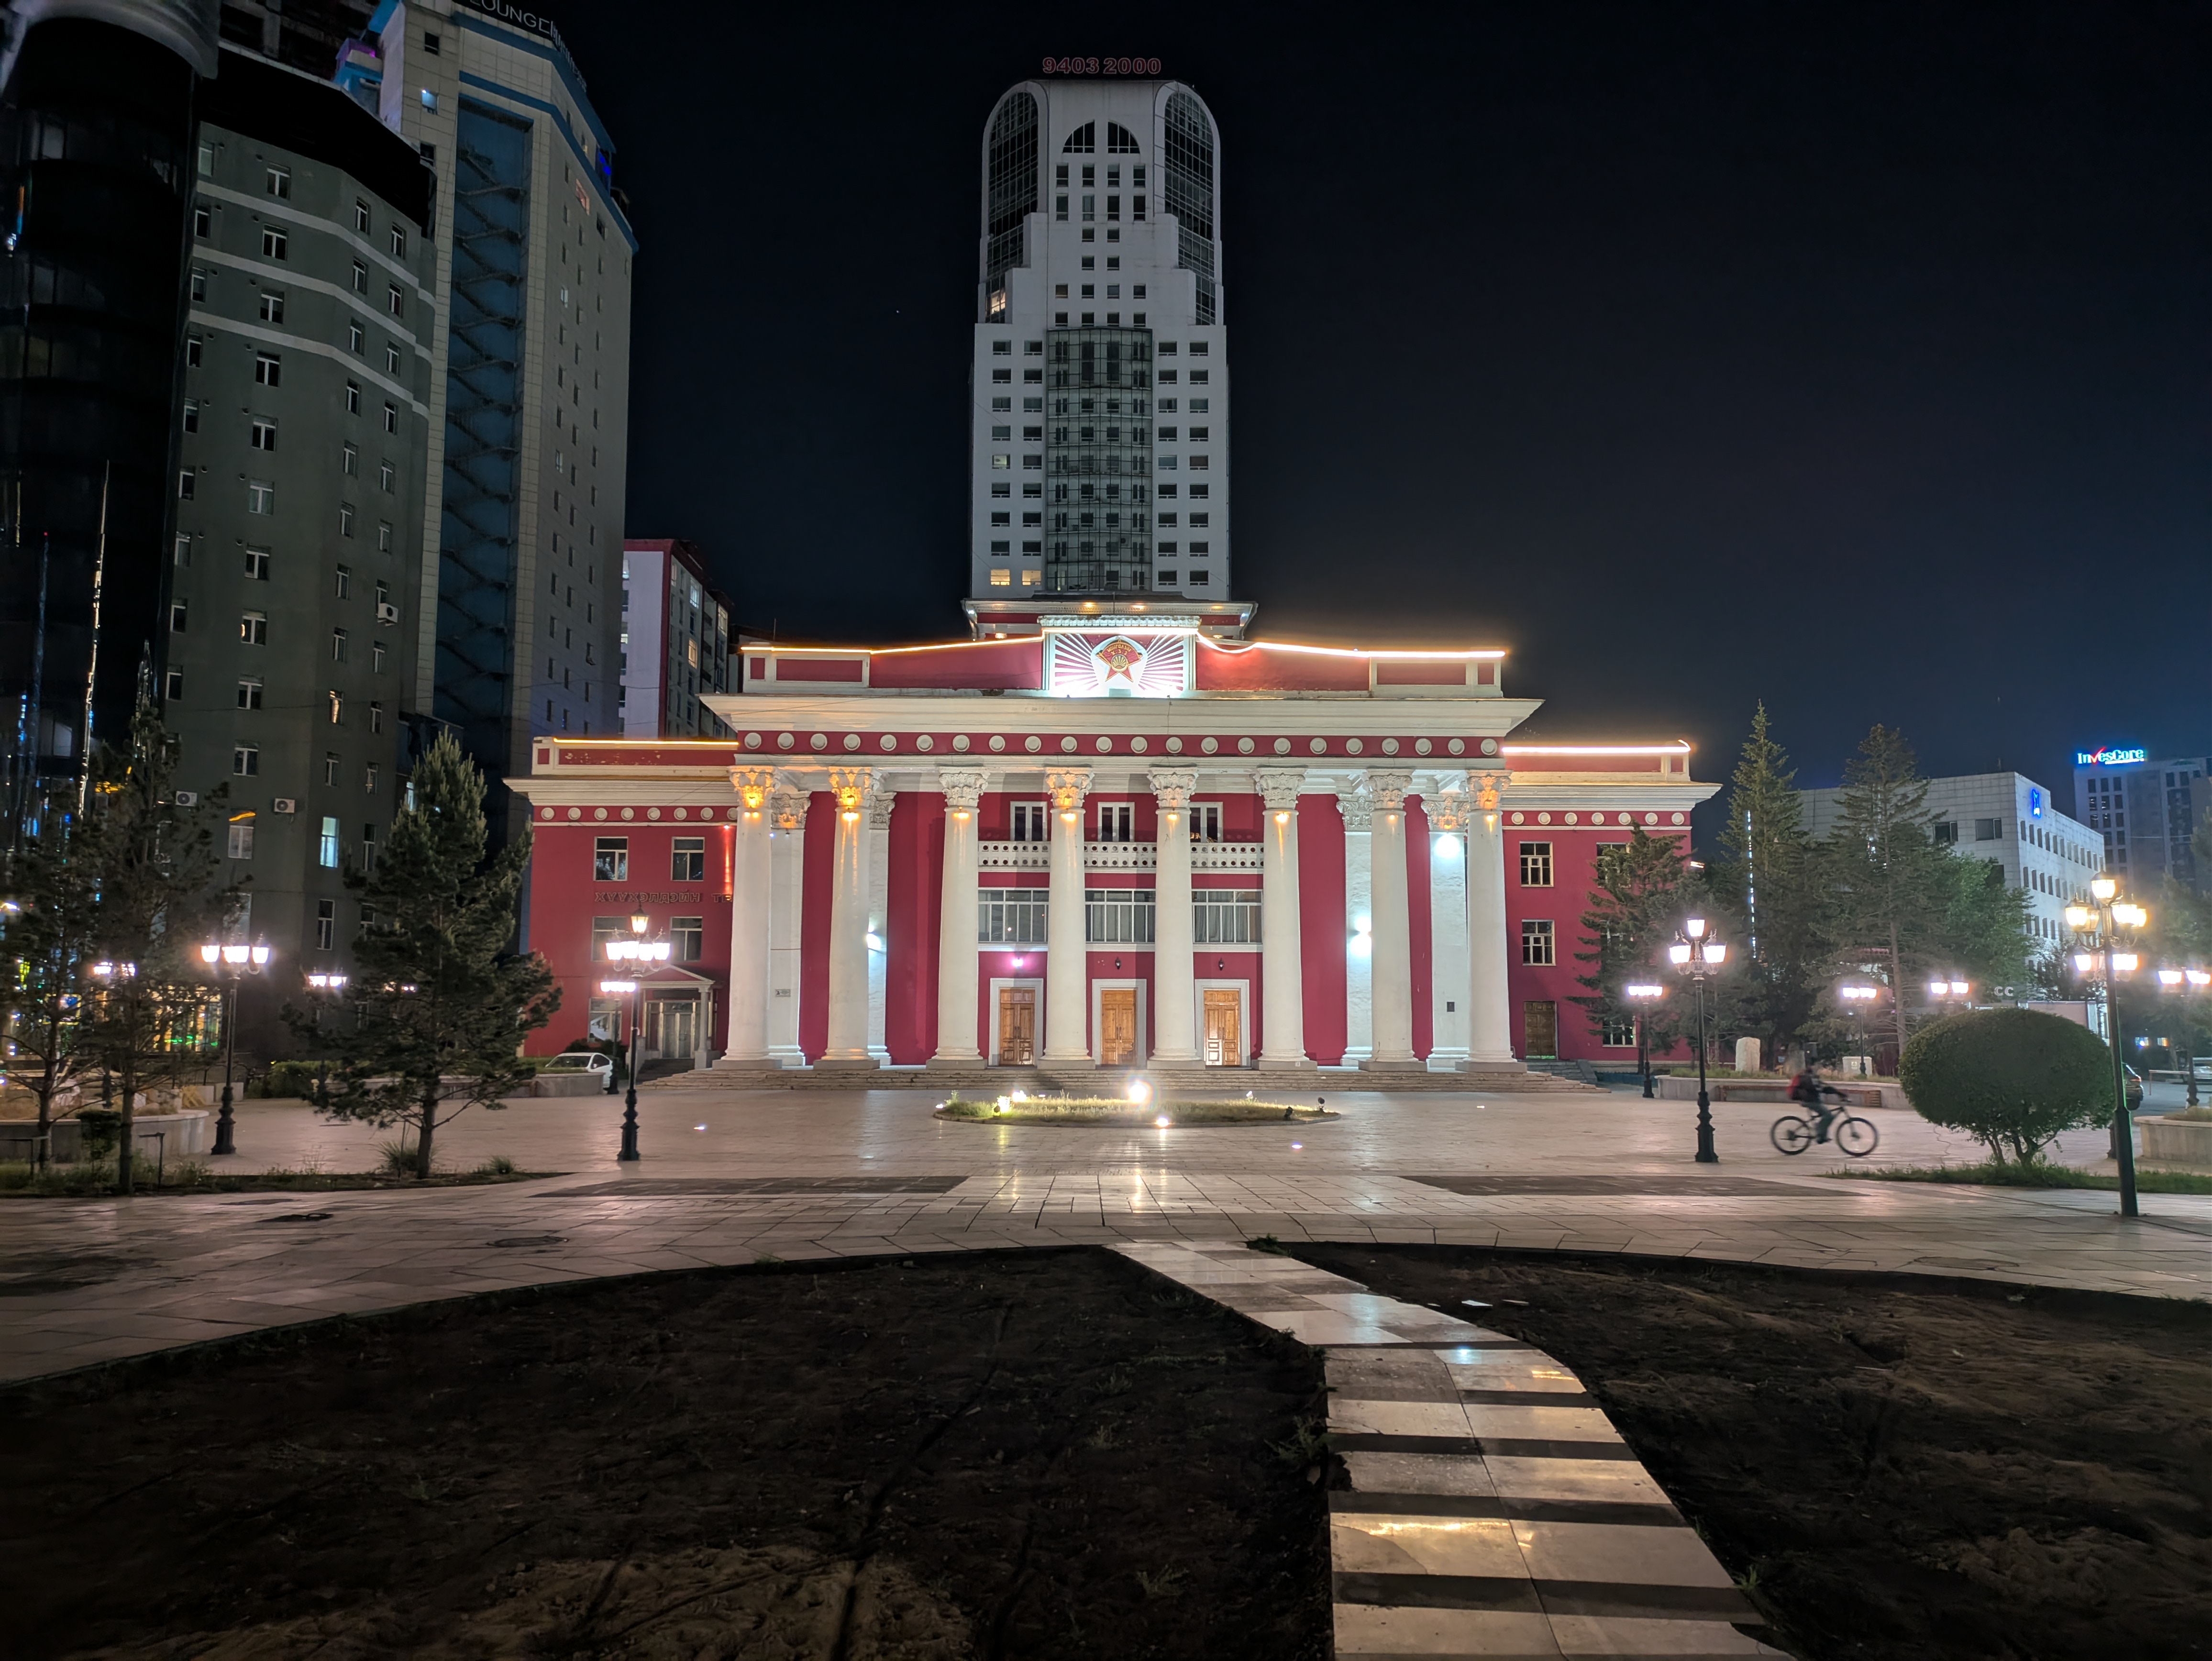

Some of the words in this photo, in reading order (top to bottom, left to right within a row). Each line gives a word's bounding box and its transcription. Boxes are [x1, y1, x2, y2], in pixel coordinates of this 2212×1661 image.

[470, 0, 550, 34] OUNGE
[1042, 57, 1099, 74] 9403
[1103, 57, 1161, 74] 2000
[2077, 747, 2144, 764] InvesCore
[595, 889, 700, 904] ХҮҮХЭЛДЭЙН
